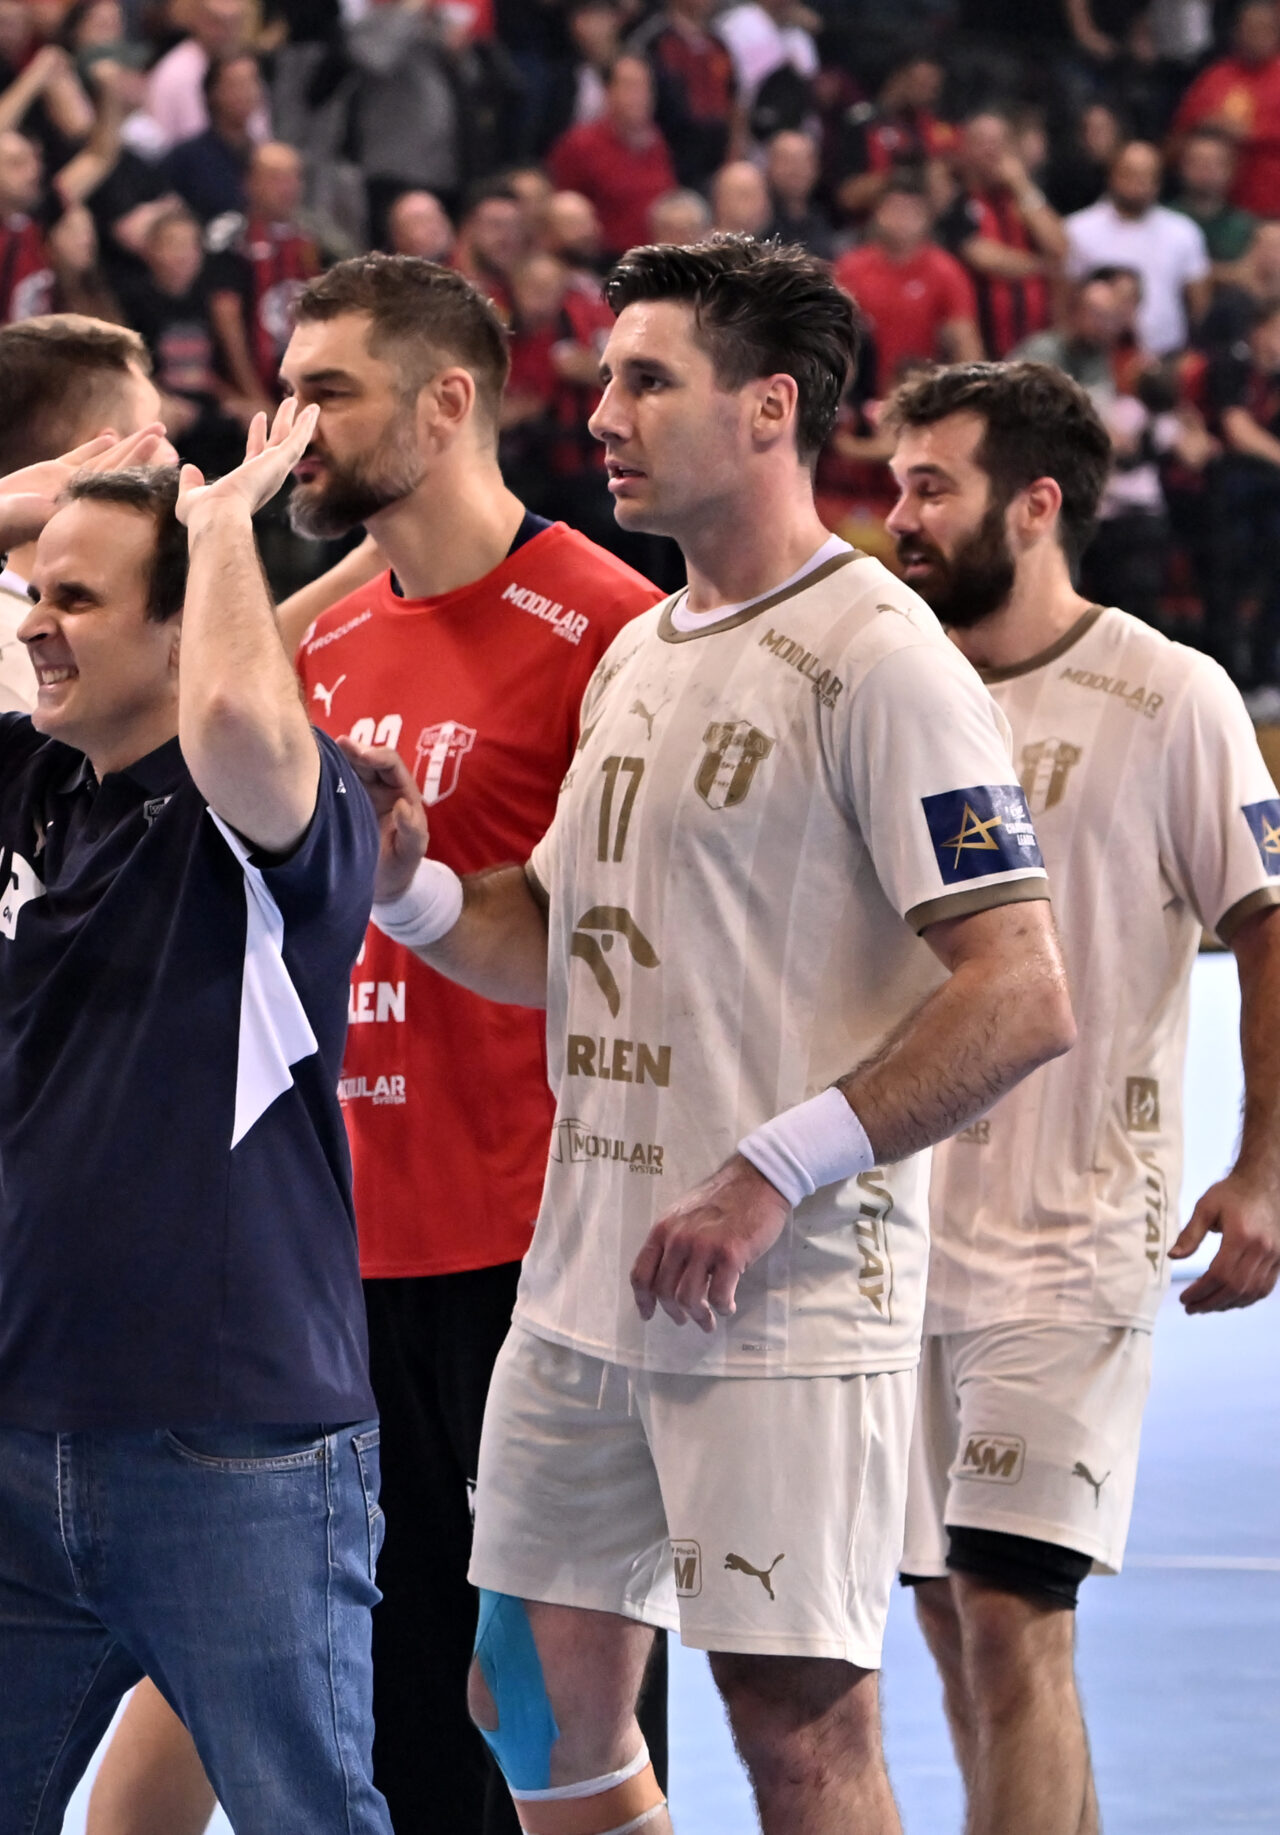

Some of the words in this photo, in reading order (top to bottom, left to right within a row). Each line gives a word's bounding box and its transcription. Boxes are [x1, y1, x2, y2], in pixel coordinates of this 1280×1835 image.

[501, 582, 590, 638] MODULAR
[758, 628, 844, 703] MODULAR
[1058, 668, 1165, 714] MODULAR
[596, 756, 646, 863] 17
[567, 1034, 672, 1088] RLEN
[628, 1164, 663, 1175] SYSTEM
[855, 1170, 894, 1315] VITAY
[963, 1439, 1018, 1477] KM
